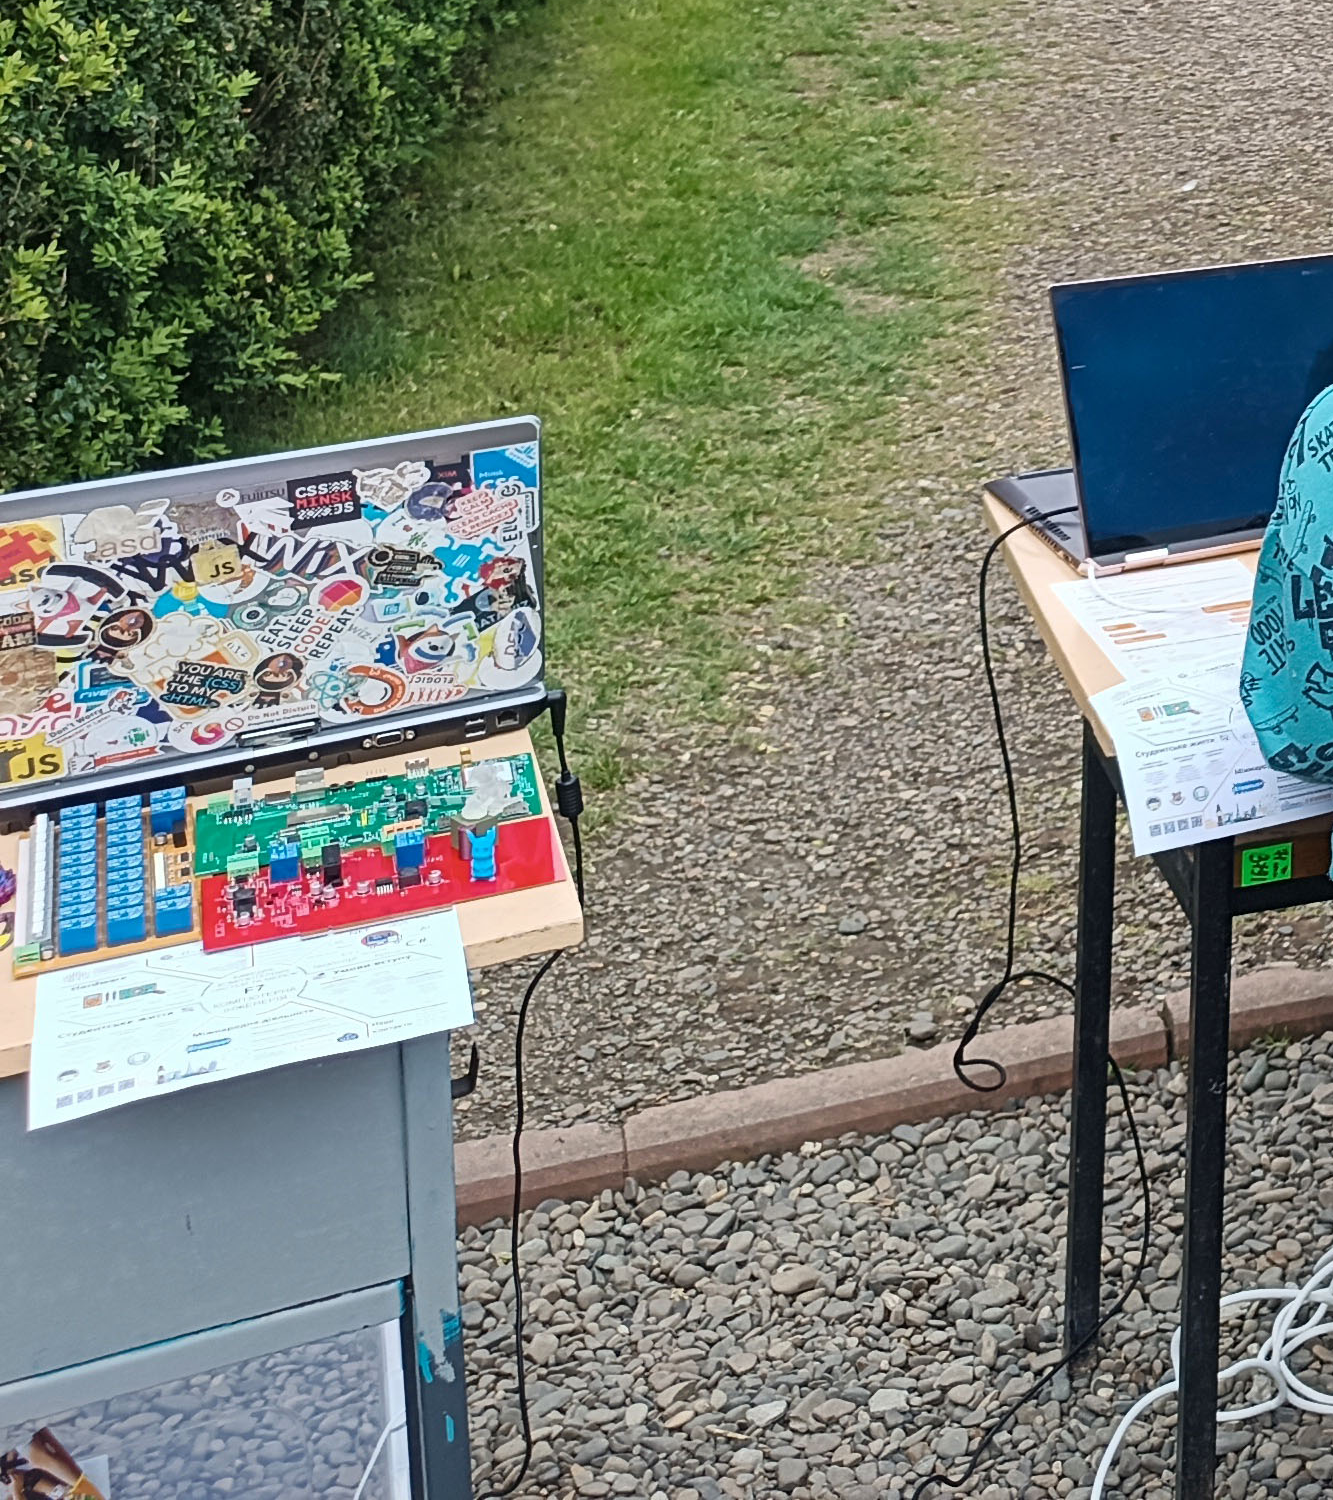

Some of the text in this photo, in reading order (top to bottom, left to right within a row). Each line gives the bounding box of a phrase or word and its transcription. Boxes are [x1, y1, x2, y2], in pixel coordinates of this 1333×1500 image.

[295, 490, 353, 510] MINSK
[332, 501, 355, 515] JS
[209, 561, 236, 579] JS
[174, 672, 205, 684] THE
[181, 662, 244, 680] YOU ARE
[168, 681, 217, 698] TO MY
[17, 752, 61, 781] JS
